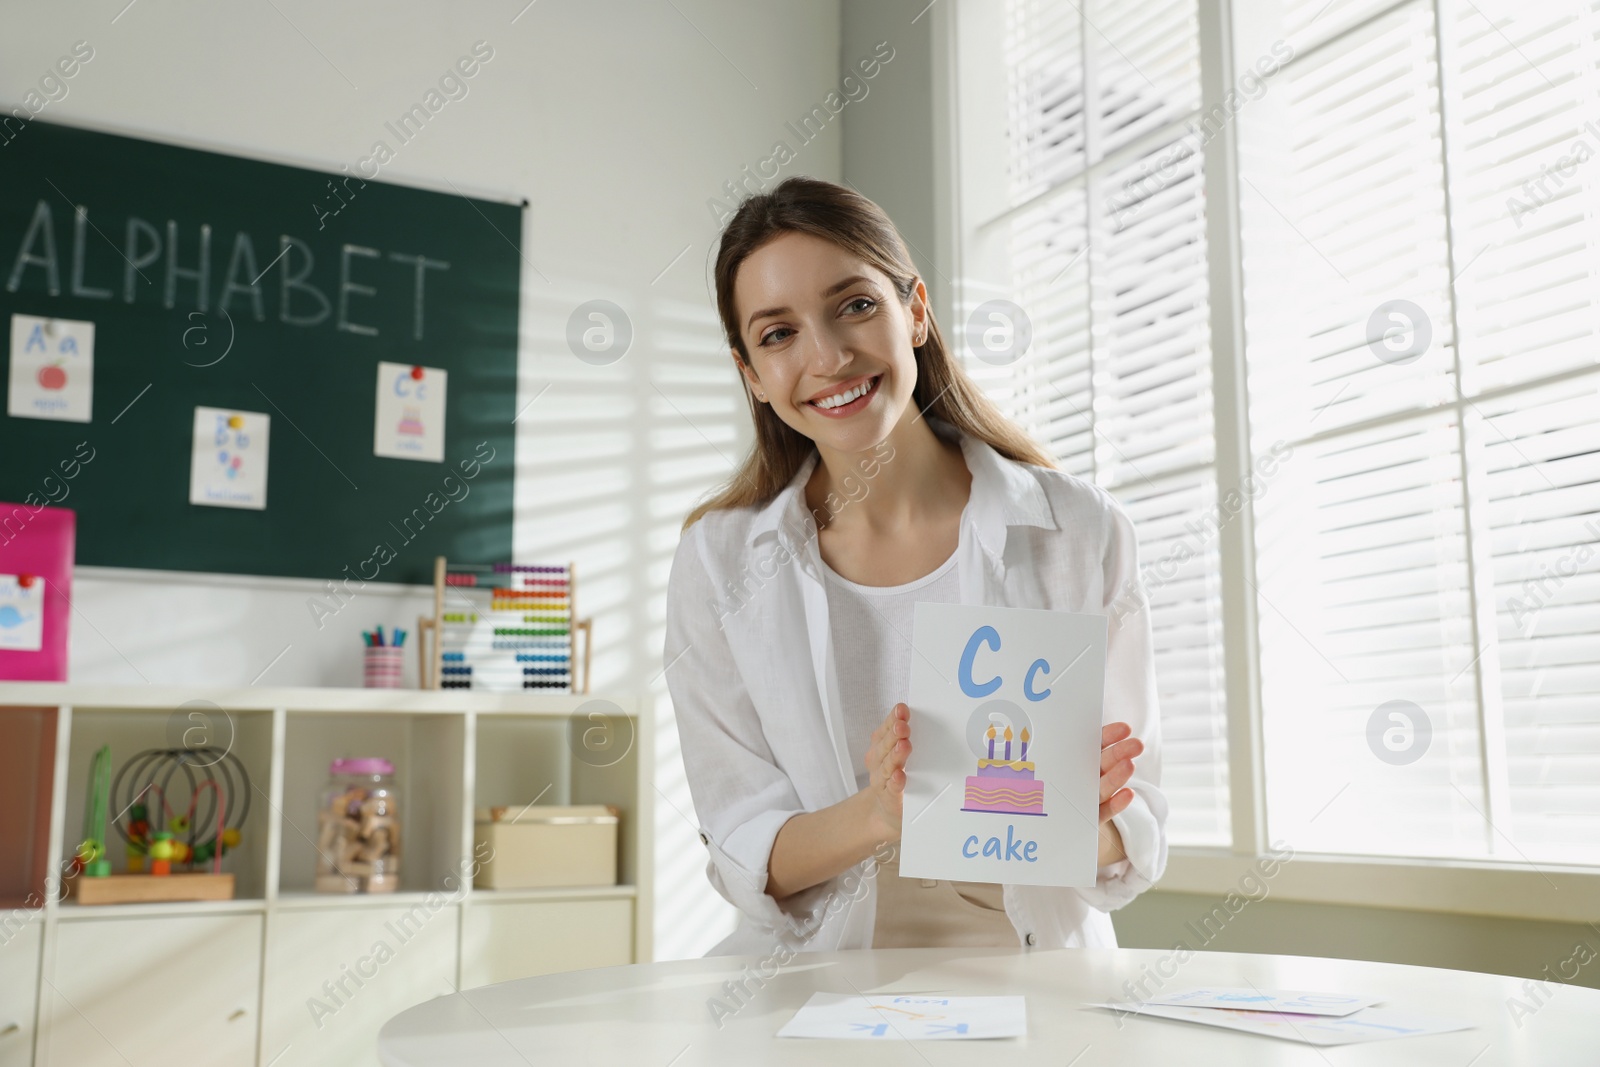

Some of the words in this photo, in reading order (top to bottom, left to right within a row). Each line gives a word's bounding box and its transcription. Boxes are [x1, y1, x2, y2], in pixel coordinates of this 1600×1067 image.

[7, 199, 450, 340] ALPHABET
[24, 323, 47, 353] A
[58, 336, 79, 356] a
[393, 372, 410, 398] C
[958, 625, 1003, 698] C
[1023, 658, 1051, 702] c
[962, 824, 1038, 863] cake
[893, 996, 948, 1005] key
[924, 1023, 968, 1035] K
